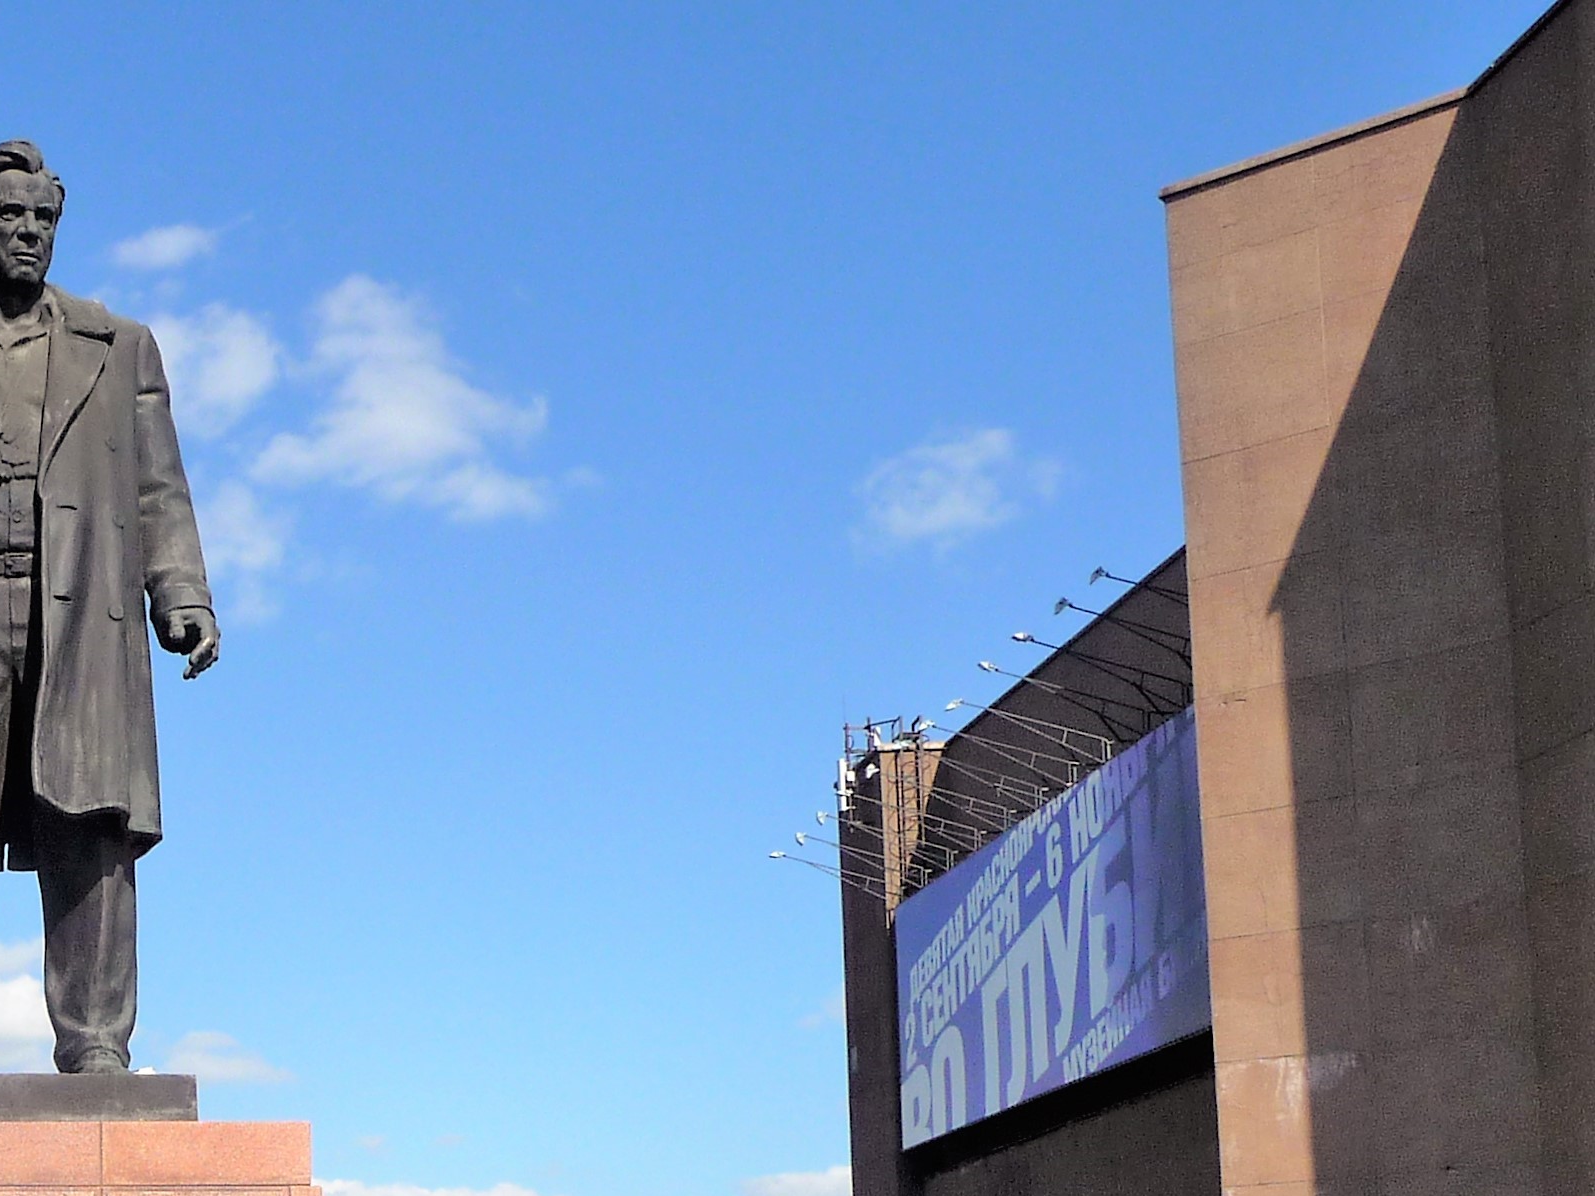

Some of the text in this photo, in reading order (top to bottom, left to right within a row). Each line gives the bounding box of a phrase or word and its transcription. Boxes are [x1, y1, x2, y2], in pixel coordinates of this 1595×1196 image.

[905, 1012, 917, 1070] 2
[921, 873, 1020, 1047] СЕНТЯБРЯ
[1046, 822, 1064, 890] 6
[910, 904, 965, 1008] ДЕВЯТАЯ
[901, 1025, 966, 1151] ВО
